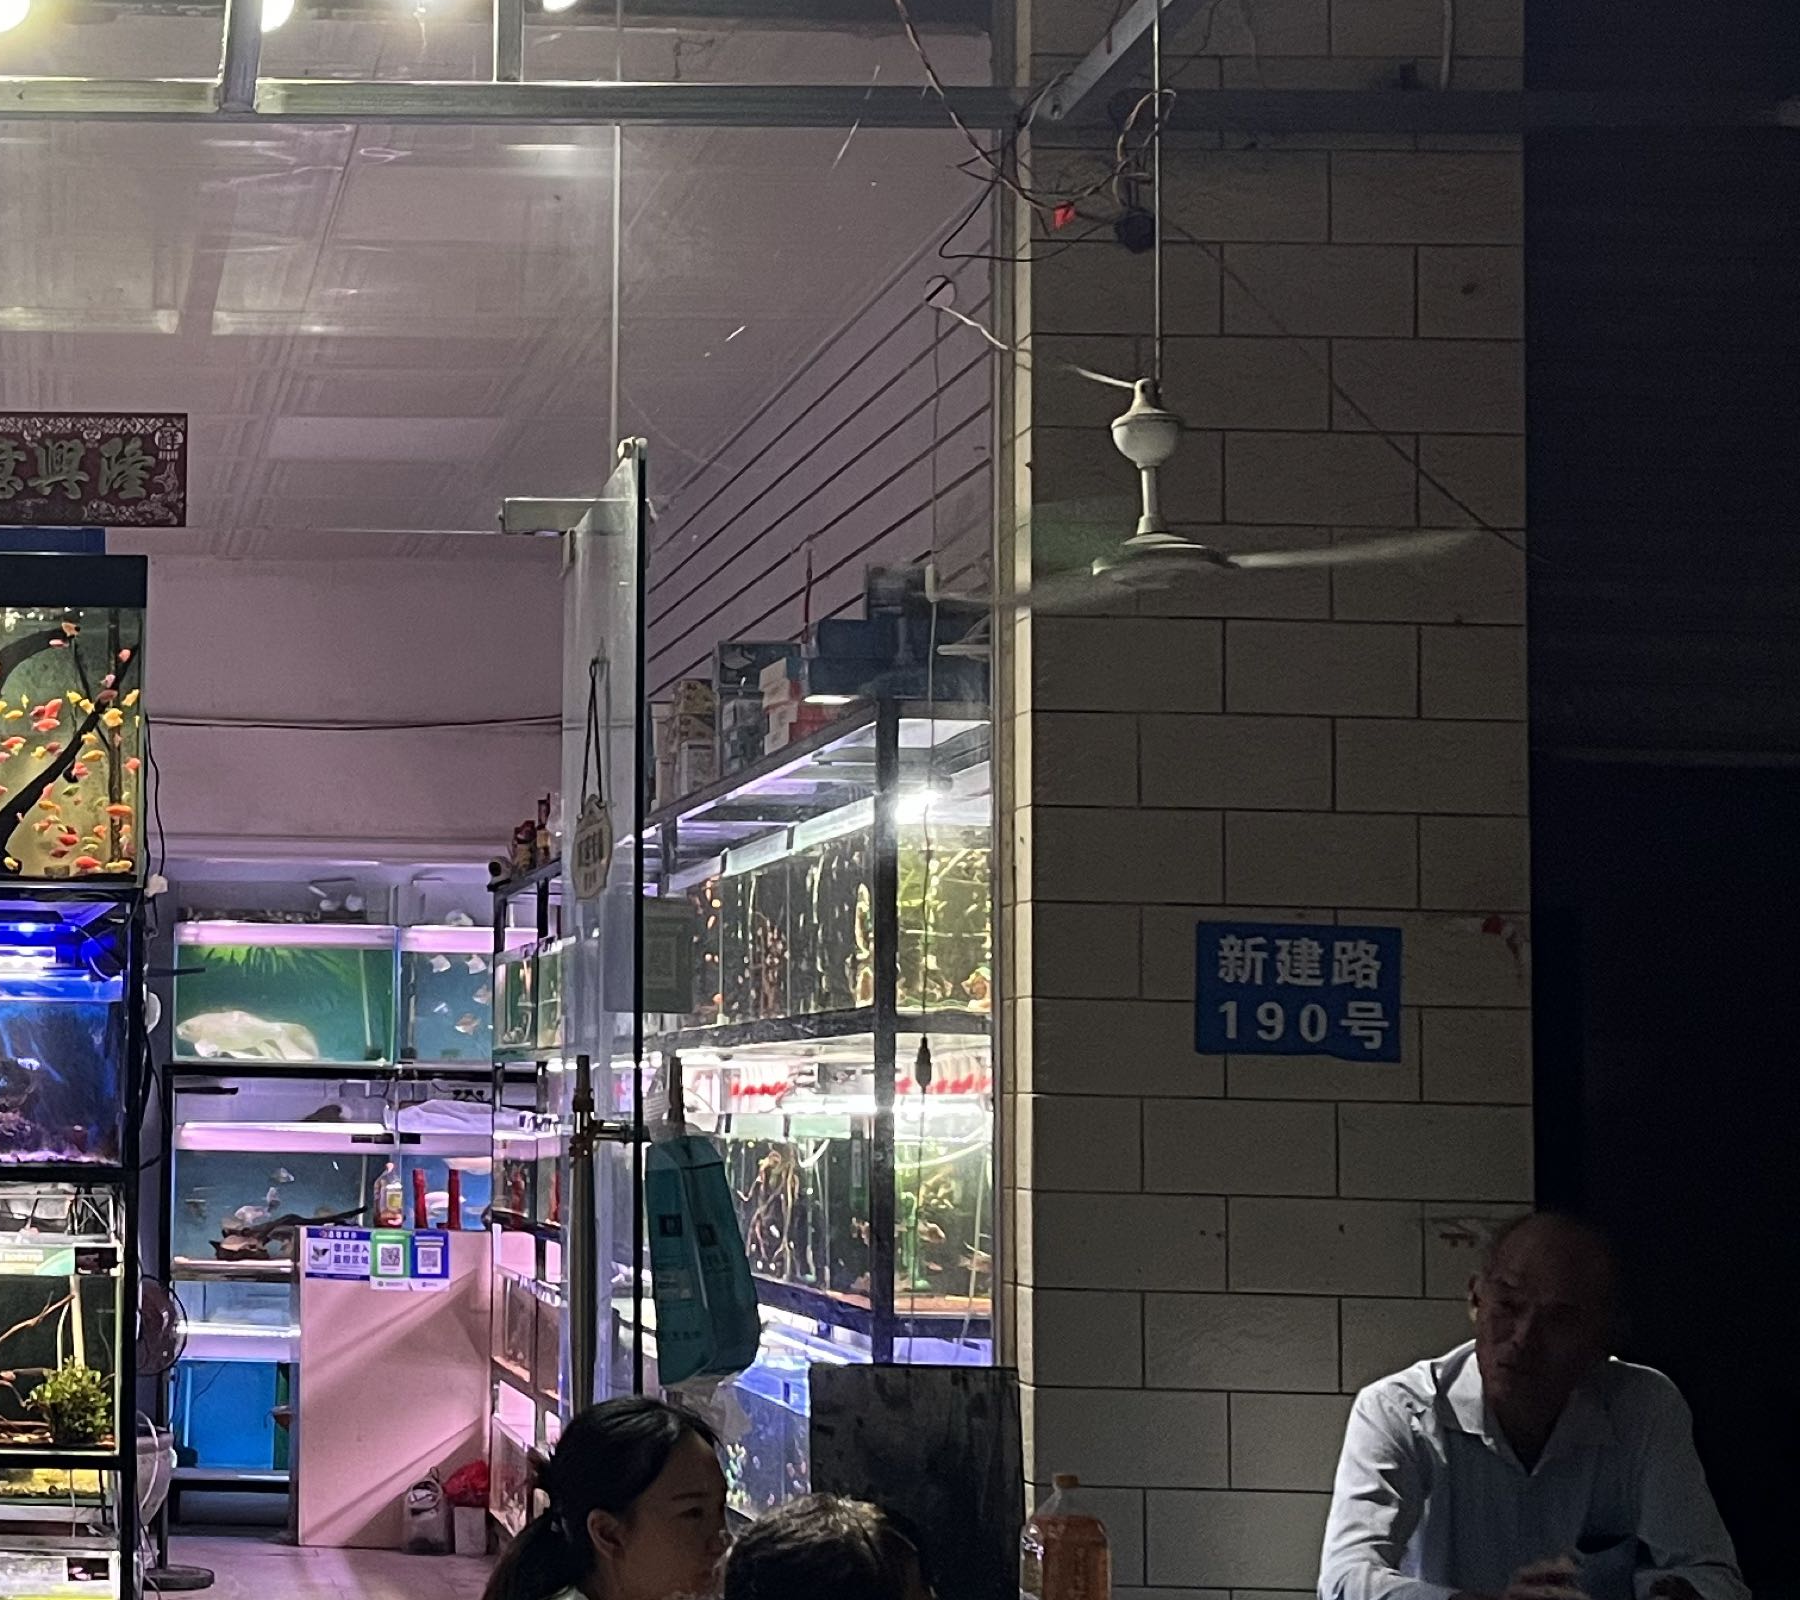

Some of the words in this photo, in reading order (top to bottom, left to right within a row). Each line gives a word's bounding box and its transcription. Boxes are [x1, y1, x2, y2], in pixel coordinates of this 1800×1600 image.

[1217, 935, 1382, 989] 新建路
[1218, 1001, 1389, 1050] 190号
